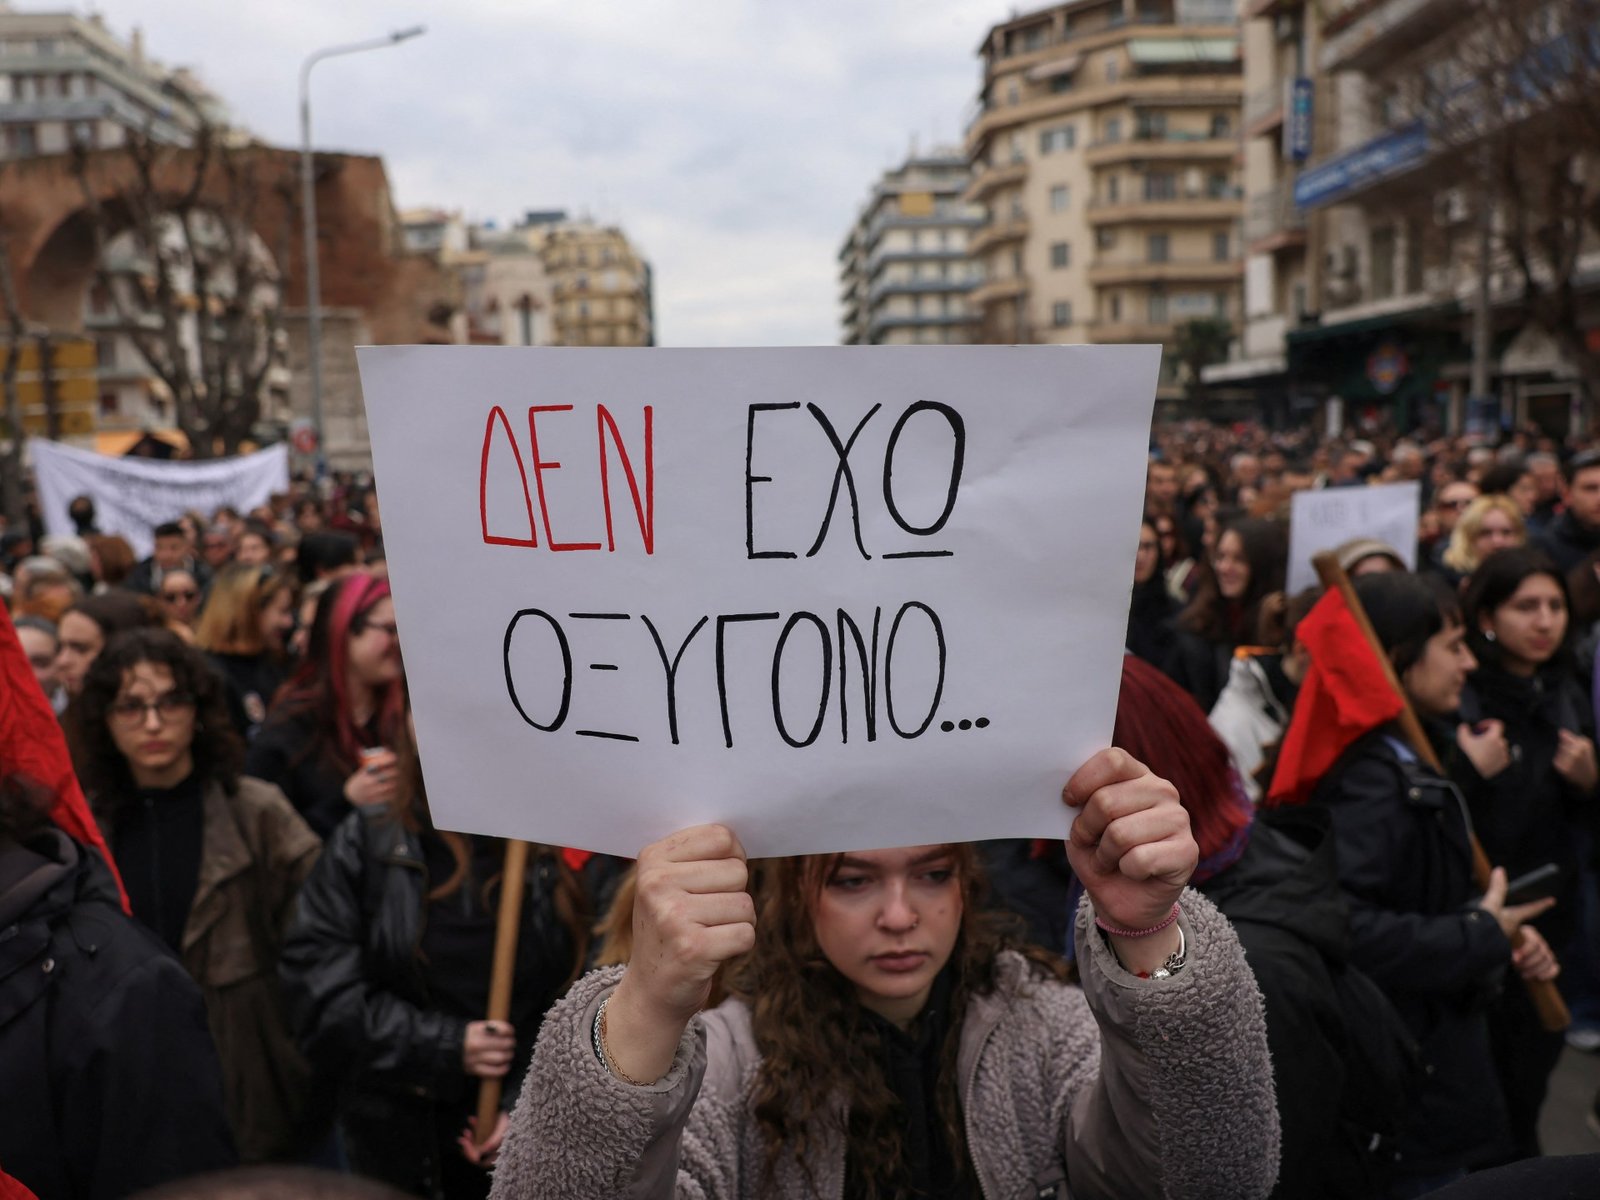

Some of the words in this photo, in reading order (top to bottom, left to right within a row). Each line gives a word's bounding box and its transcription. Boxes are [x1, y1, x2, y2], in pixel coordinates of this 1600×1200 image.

[480, 404, 653, 555] ΔΕΝ
[746, 400, 966, 560] ΕΧΩ
[504, 601, 990, 748] ΟΞΥΓΟΝΟ...
